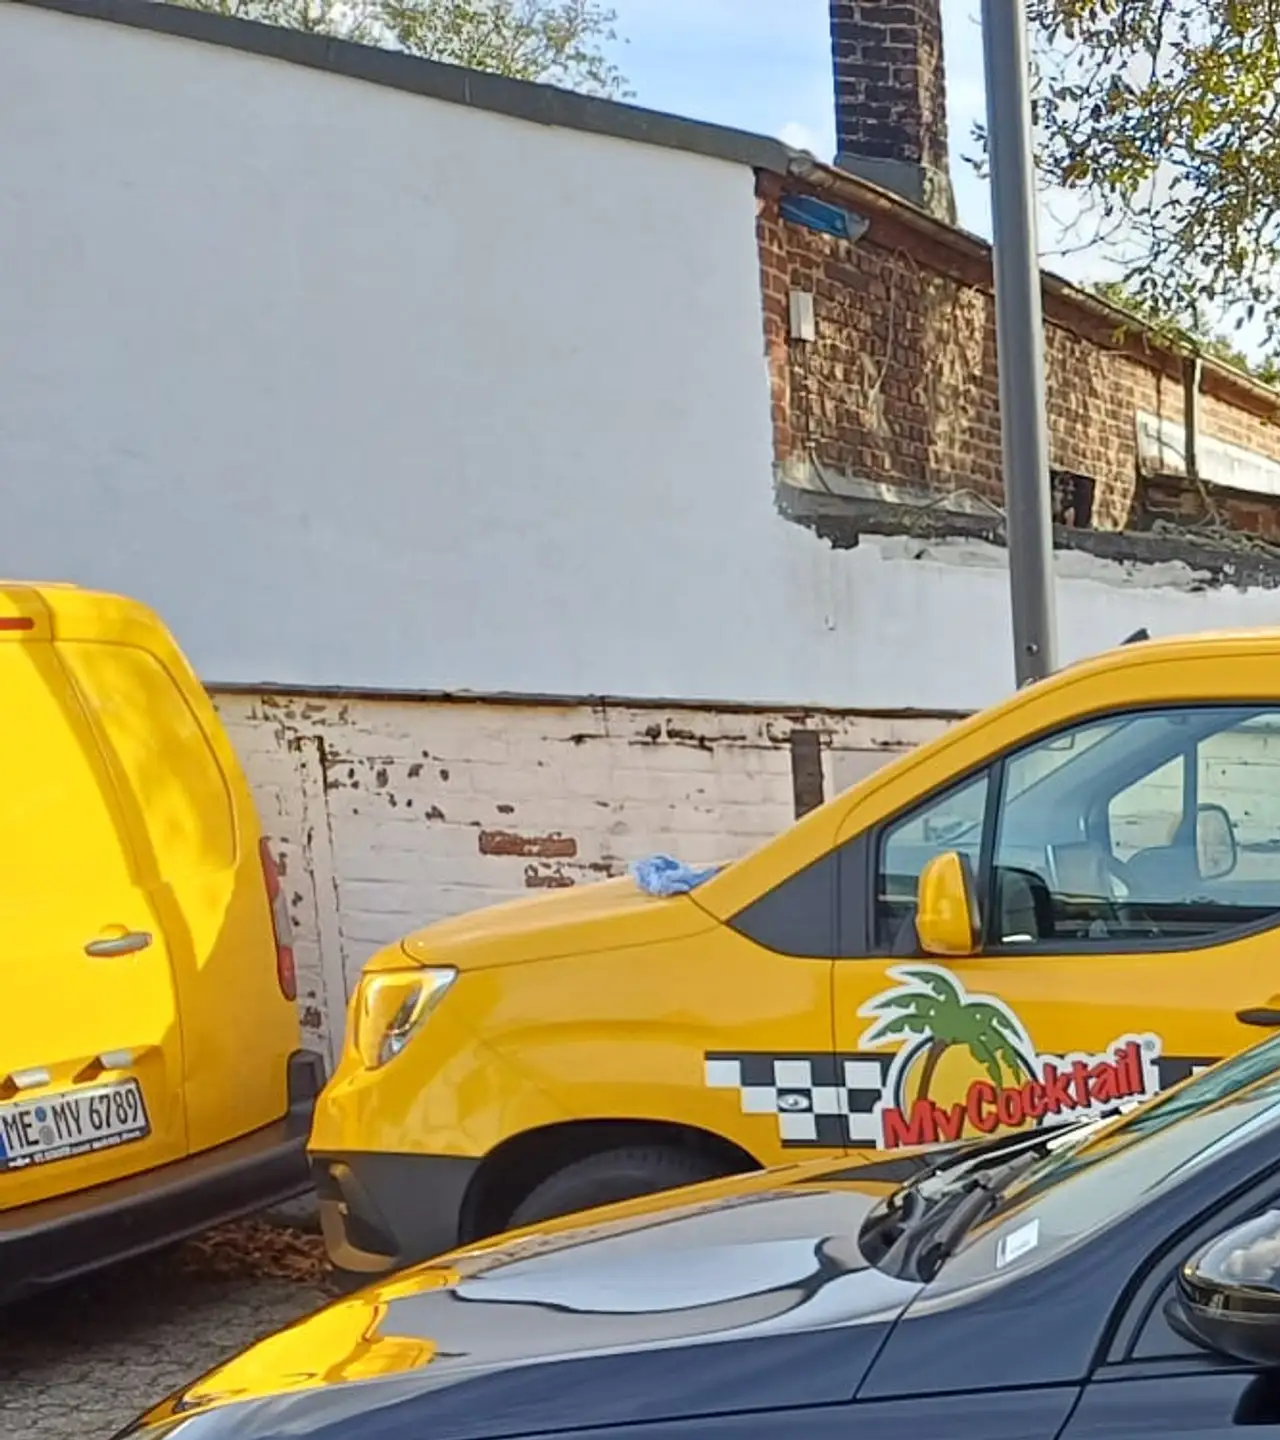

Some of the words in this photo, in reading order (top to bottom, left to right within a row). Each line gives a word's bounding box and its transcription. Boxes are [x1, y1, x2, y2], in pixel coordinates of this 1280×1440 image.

[2, 1111, 40, 1151] ME
[51, 1100, 82, 1140] MY
[89, 1088, 138, 1131] 6789
